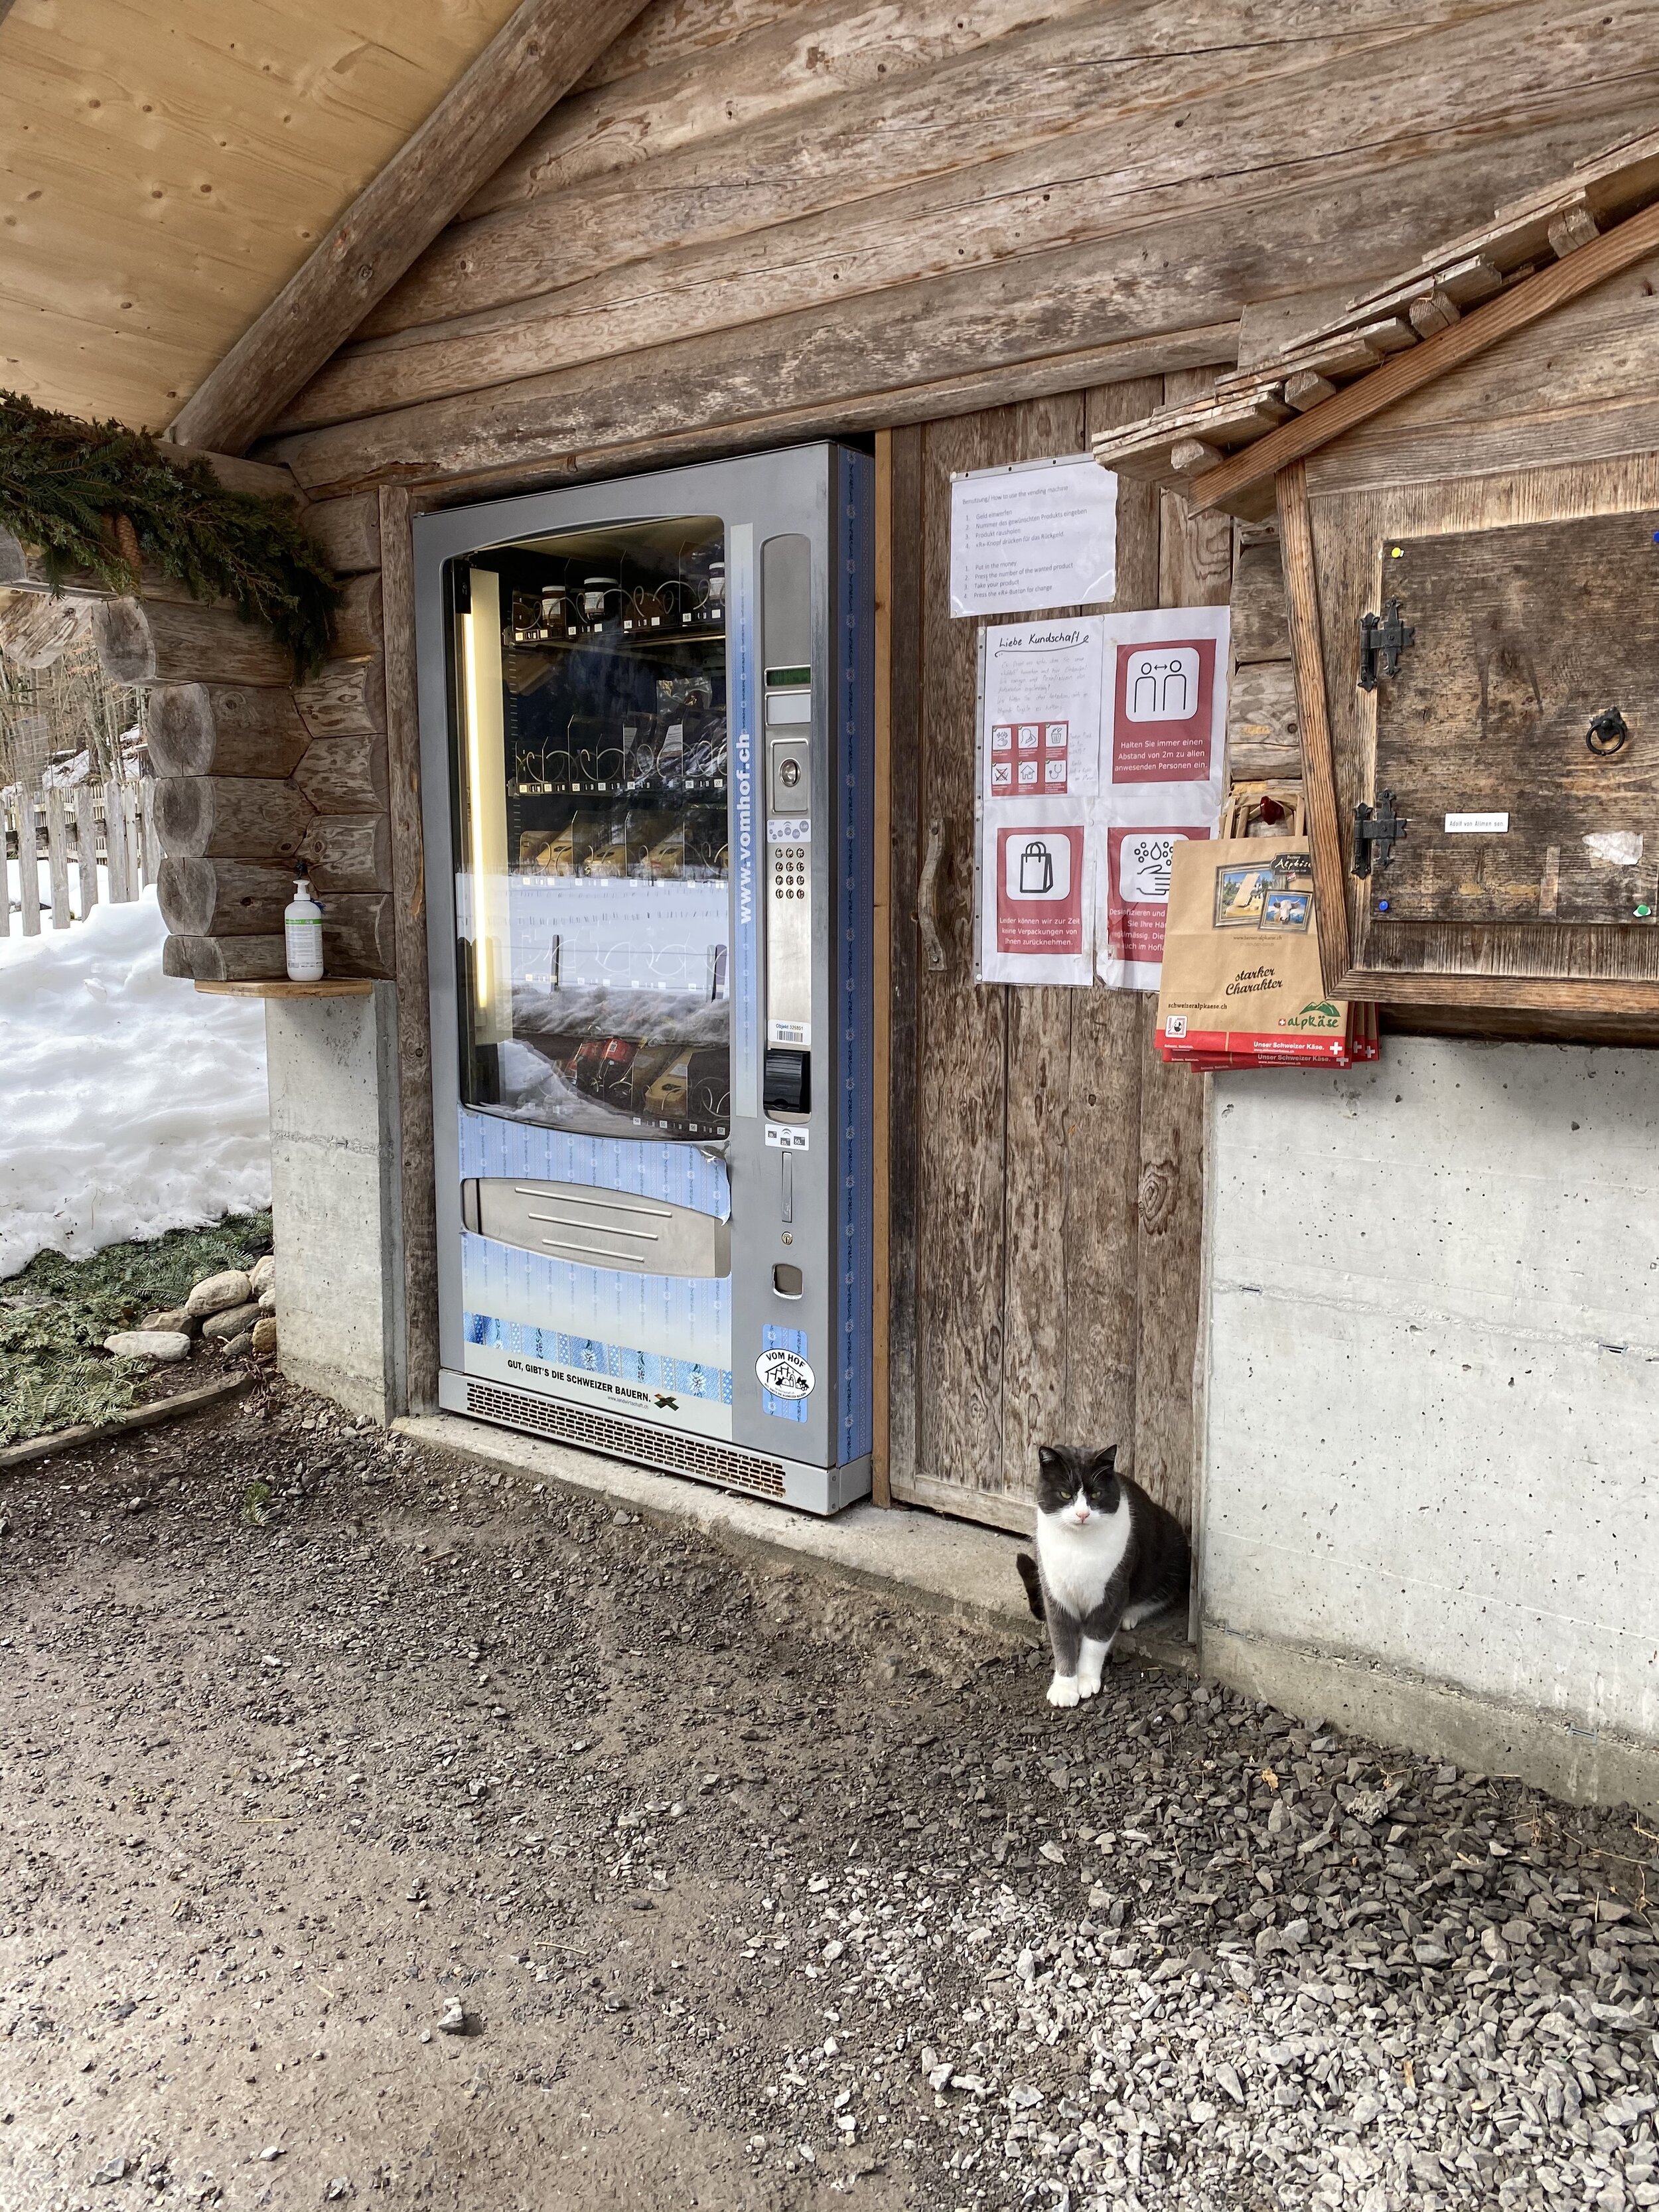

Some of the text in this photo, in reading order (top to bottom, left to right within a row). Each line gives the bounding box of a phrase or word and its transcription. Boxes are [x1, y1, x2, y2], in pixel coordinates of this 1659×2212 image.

[1008, 516, 1040, 526] gewünschten
[1041, 512, 1062, 520] Produkts
[1064, 508, 1087, 517] eingeben
[975, 530, 995, 539] Produkt
[996, 528, 1021, 536] rausholen
[1002, 536, 1022, 545] drücken
[999, 579, 1019, 588] product
[999, 630, 1080, 647] Liebe Kundschaft
[736, 734, 751, 924] www.vomhof.ch
[1235, 966, 1275, 982] starker
[1226, 978, 1283, 995] Charakter
[1288, 1015, 1339, 1029] alpkäse
[766, 1352, 806, 1367] VOM HOF
[507, 1359, 651, 1402] GUT, GIBT'S DIE SCHWEIZER BAUERN.
